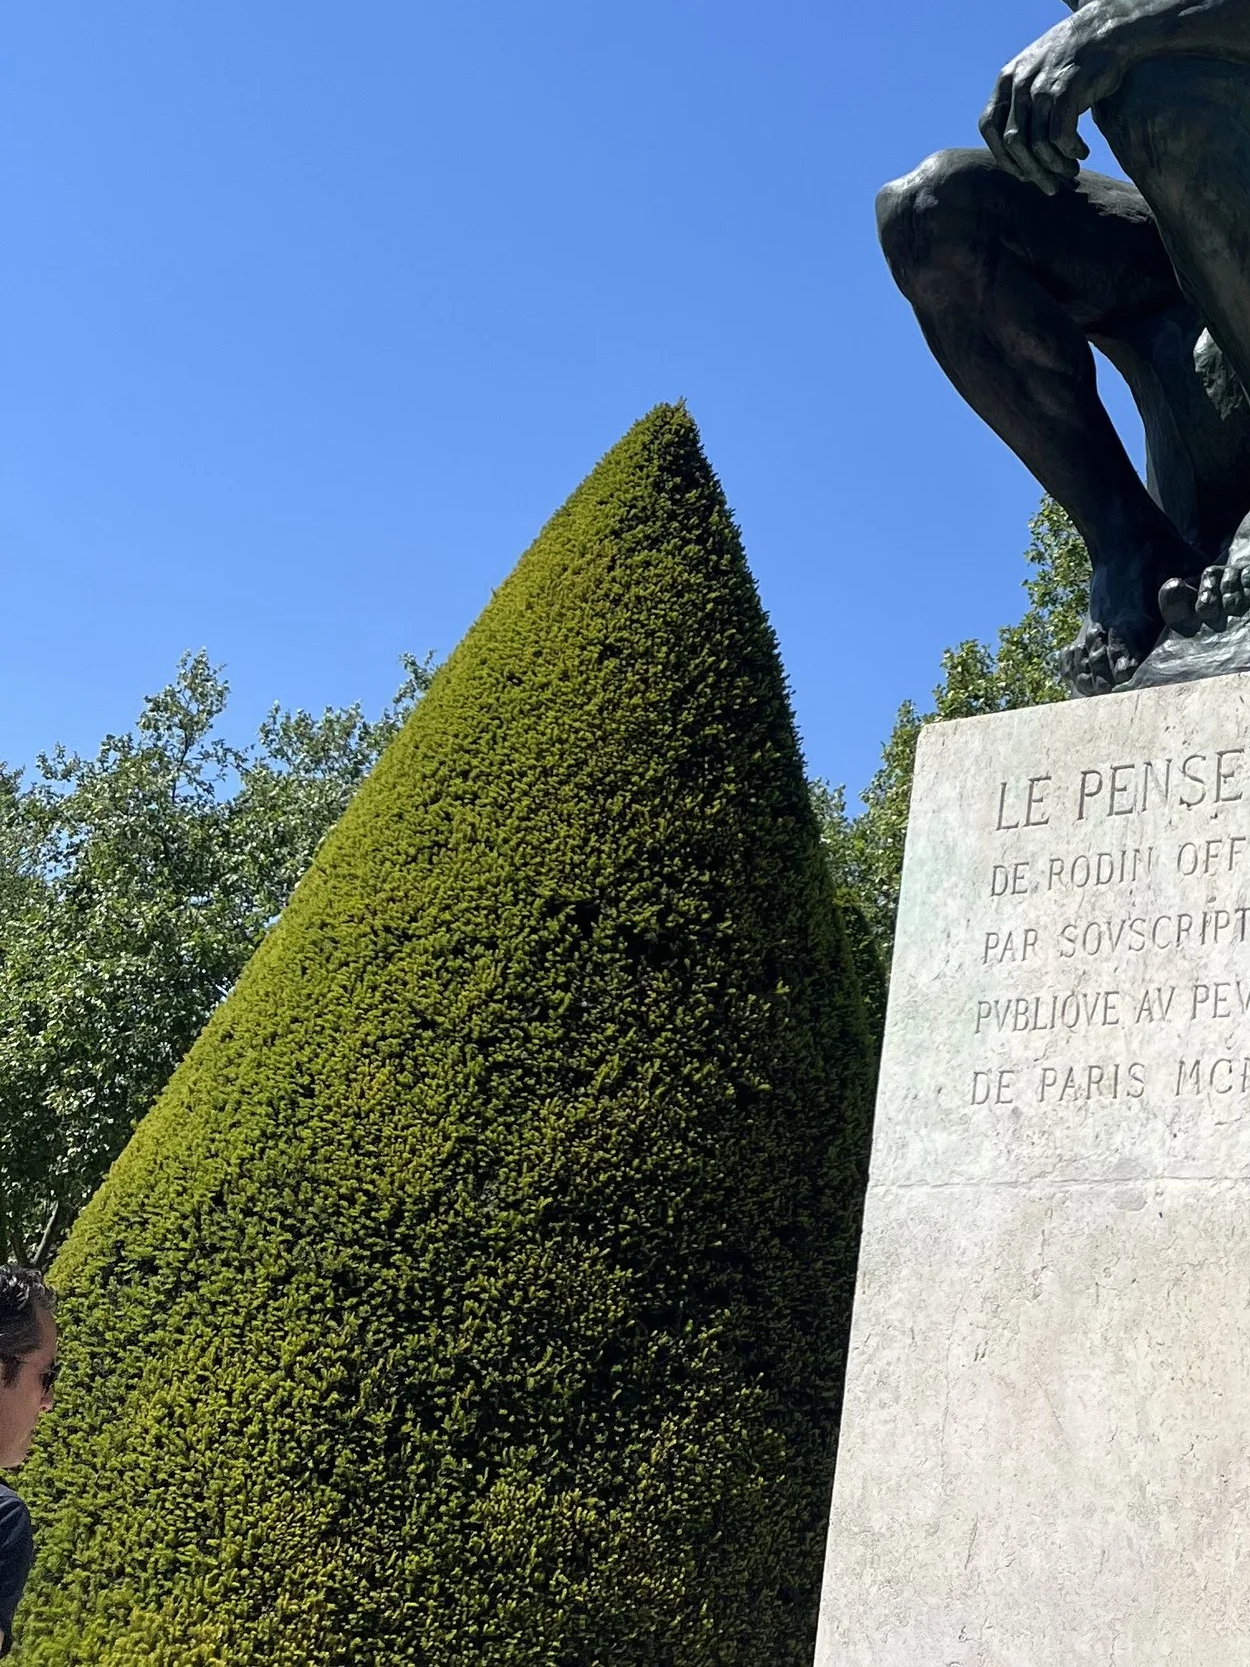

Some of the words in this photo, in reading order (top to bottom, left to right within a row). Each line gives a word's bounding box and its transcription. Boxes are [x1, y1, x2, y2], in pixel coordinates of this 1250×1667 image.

[995, 775, 1052, 831] LE
[990, 862, 1030, 897] DE
[1048, 847, 1154, 891] RODIN
[983, 928, 1038, 965] PAR
[1135, 986, 1176, 1024] AV
[970, 1070, 1014, 1106] DE
[1038, 1062, 1146, 1103] PARIS
